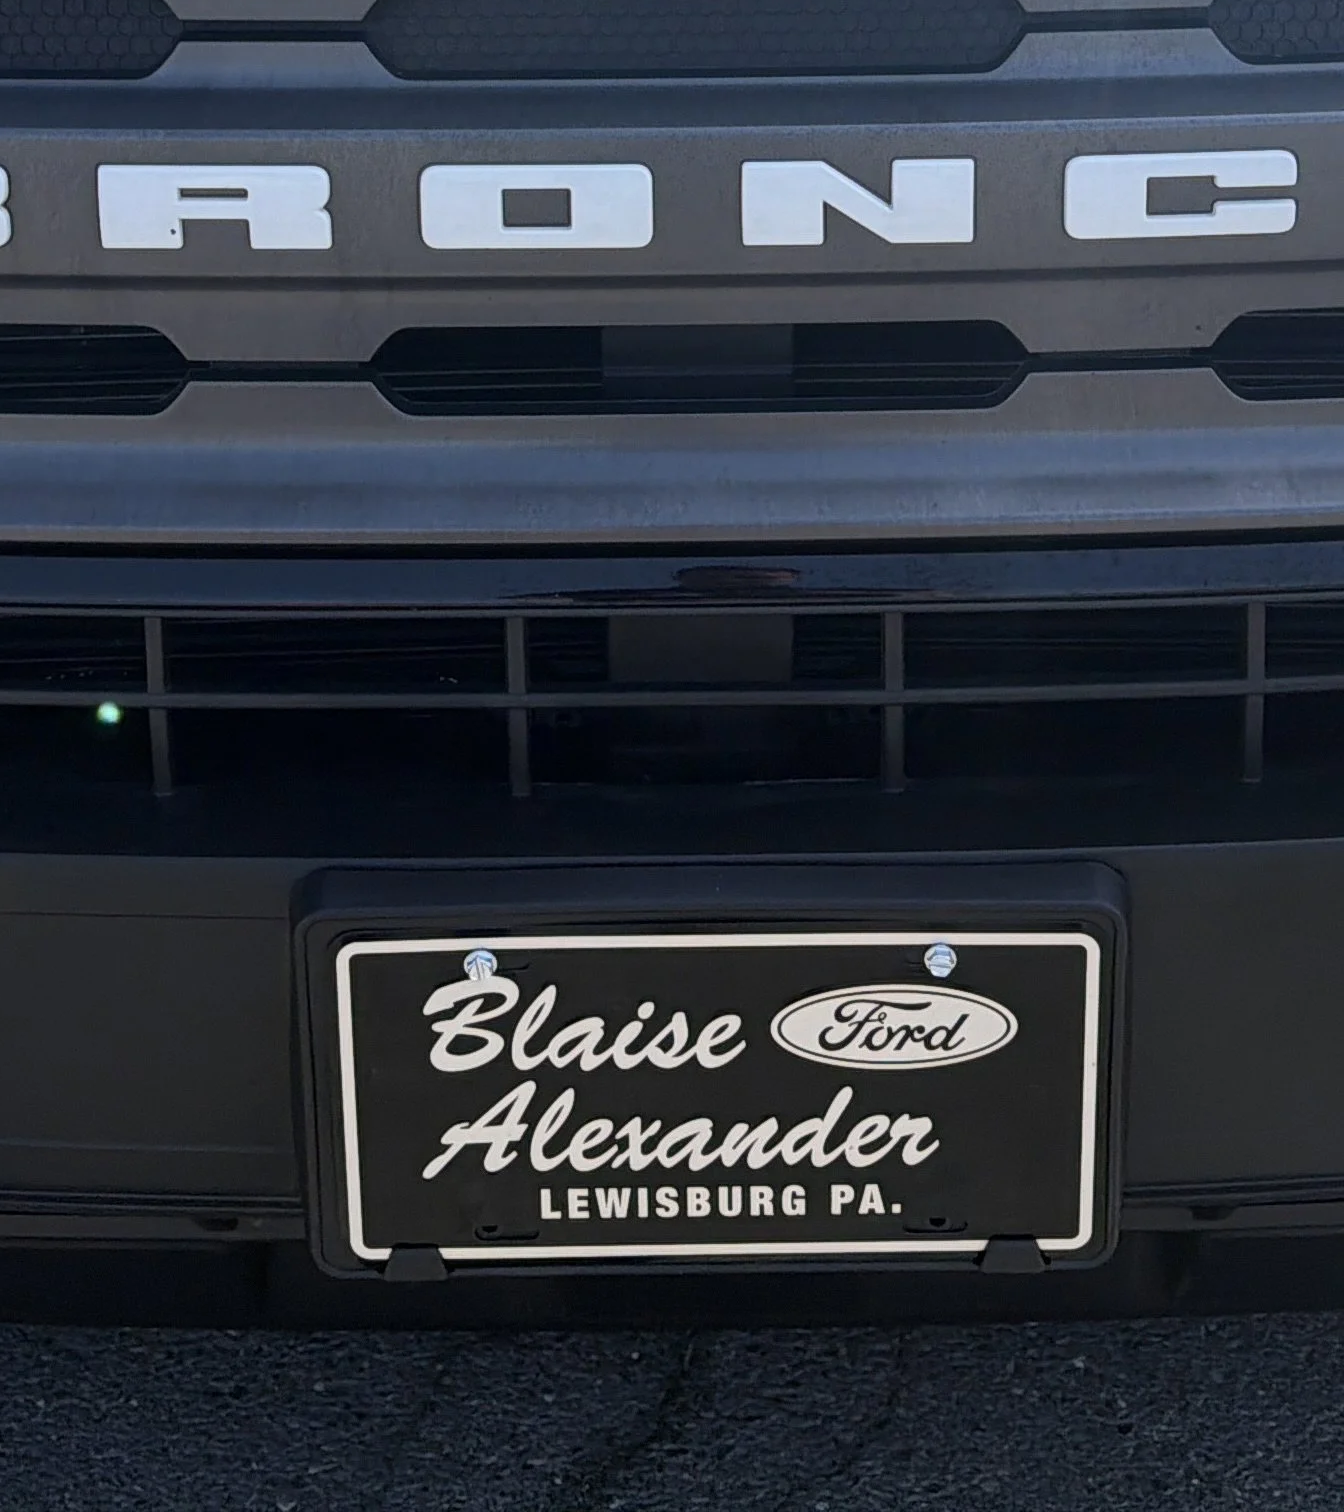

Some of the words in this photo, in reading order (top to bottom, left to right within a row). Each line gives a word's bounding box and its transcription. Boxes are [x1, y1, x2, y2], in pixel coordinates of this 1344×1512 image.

[422, 975, 747, 1072] Blaise
[817, 997, 966, 1053] Ford
[422, 1080, 940, 1180] Alexander
[540, 1183, 807, 1220] LEWISBURG
[830, 1183, 903, 1216] PA.
